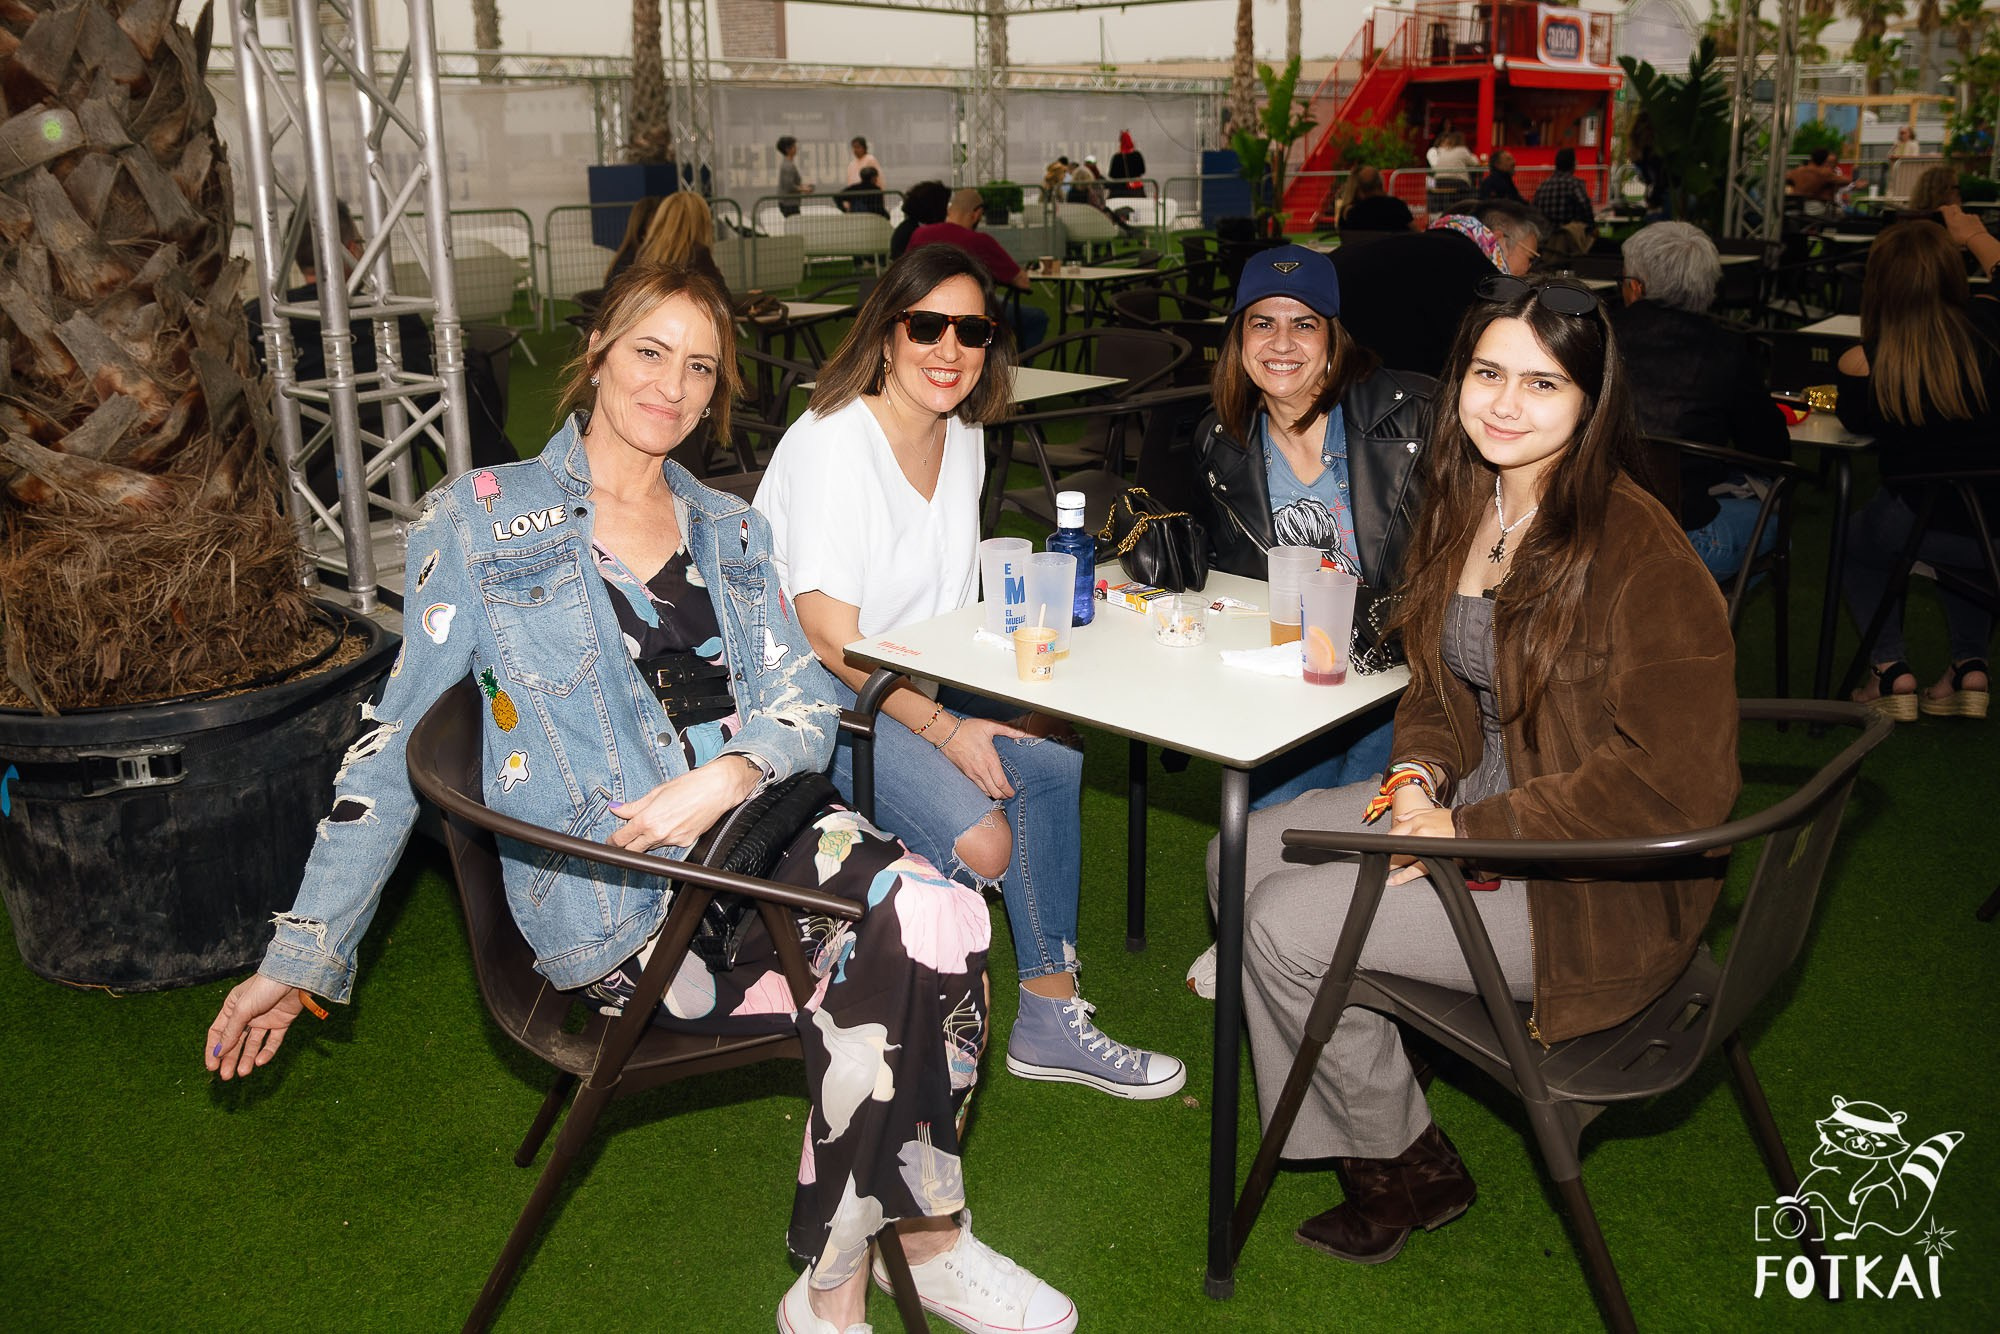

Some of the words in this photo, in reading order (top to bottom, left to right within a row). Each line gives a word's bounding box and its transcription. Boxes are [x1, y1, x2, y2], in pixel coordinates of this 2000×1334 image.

[492, 503, 568, 541] LOVE
[1004, 563, 1011, 574] E
[1004, 576, 1025, 605] M
[1005, 625, 1019, 634] LIVE
